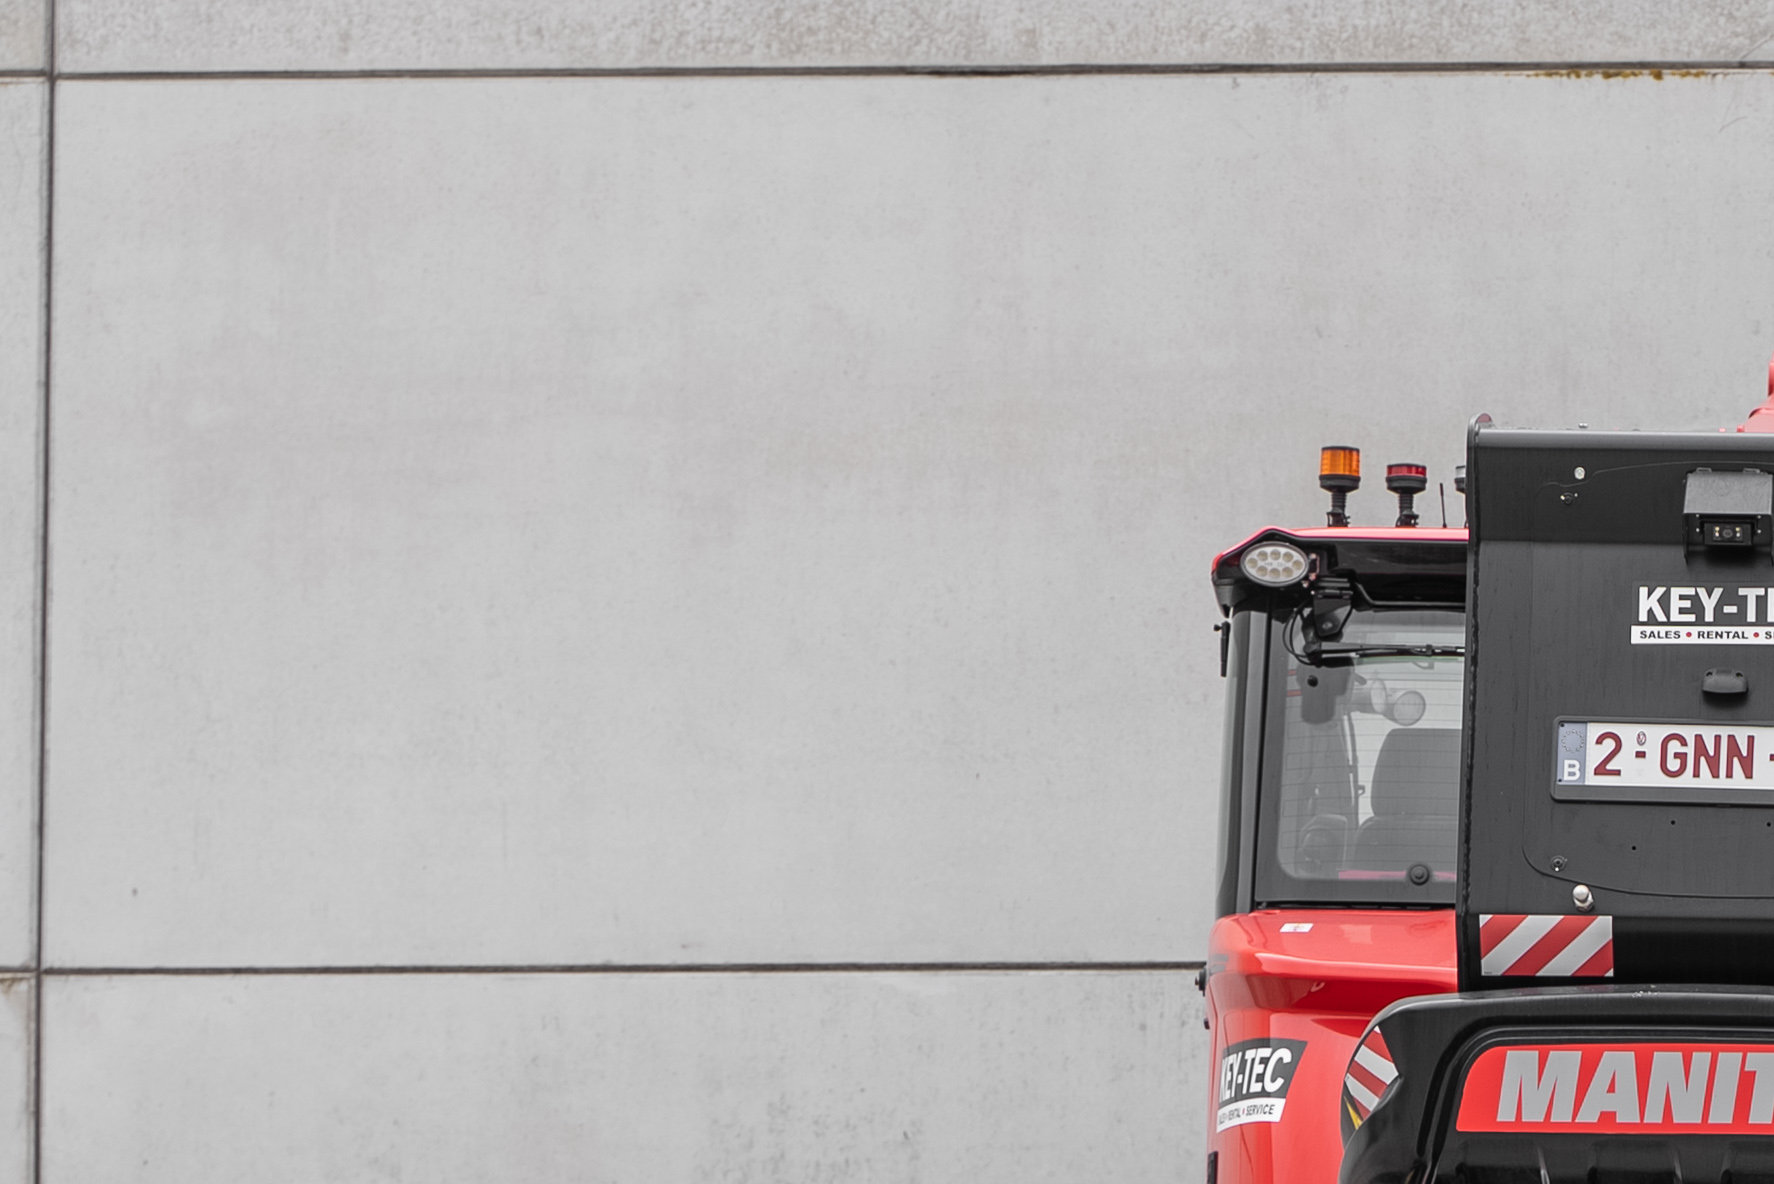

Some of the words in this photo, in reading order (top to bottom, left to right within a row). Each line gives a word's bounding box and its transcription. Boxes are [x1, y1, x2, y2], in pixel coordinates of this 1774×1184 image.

[1639, 630, 1681, 639] SALES
[1697, 630, 1749, 640] RENTAL
[1563, 759, 1581, 781] B
[1245, 1103, 1276, 1117] SERVICE
